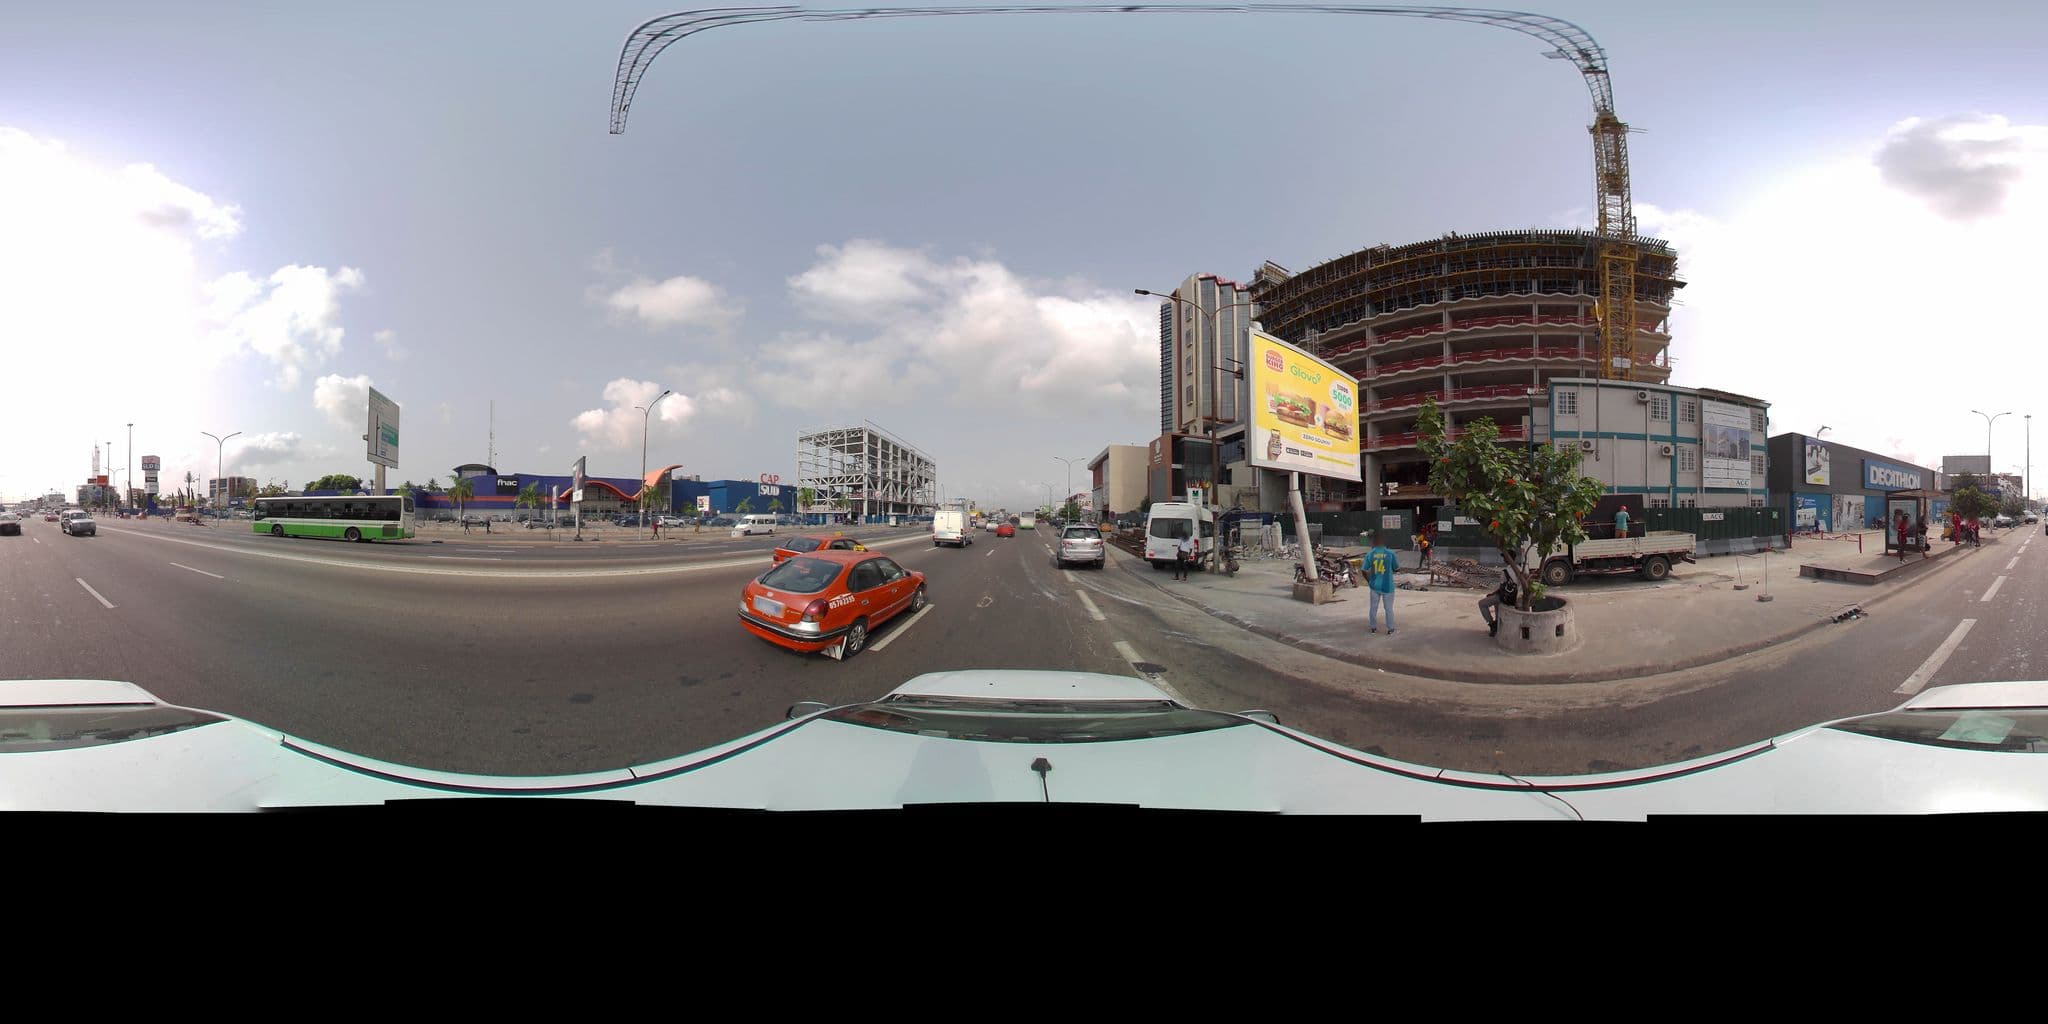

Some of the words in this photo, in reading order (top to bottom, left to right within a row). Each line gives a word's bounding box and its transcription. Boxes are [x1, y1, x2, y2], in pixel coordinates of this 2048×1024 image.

[1266, 358, 1283, 370] KING
[1290, 365, 1321, 384] Glovo
[1332, 389, 1352, 407] 5000
[760, 473, 779, 484] CAP
[1869, 465, 1920, 489] DECATHLON
[760, 485, 780, 496] SUD
[1373, 559, 1385, 574] 14
